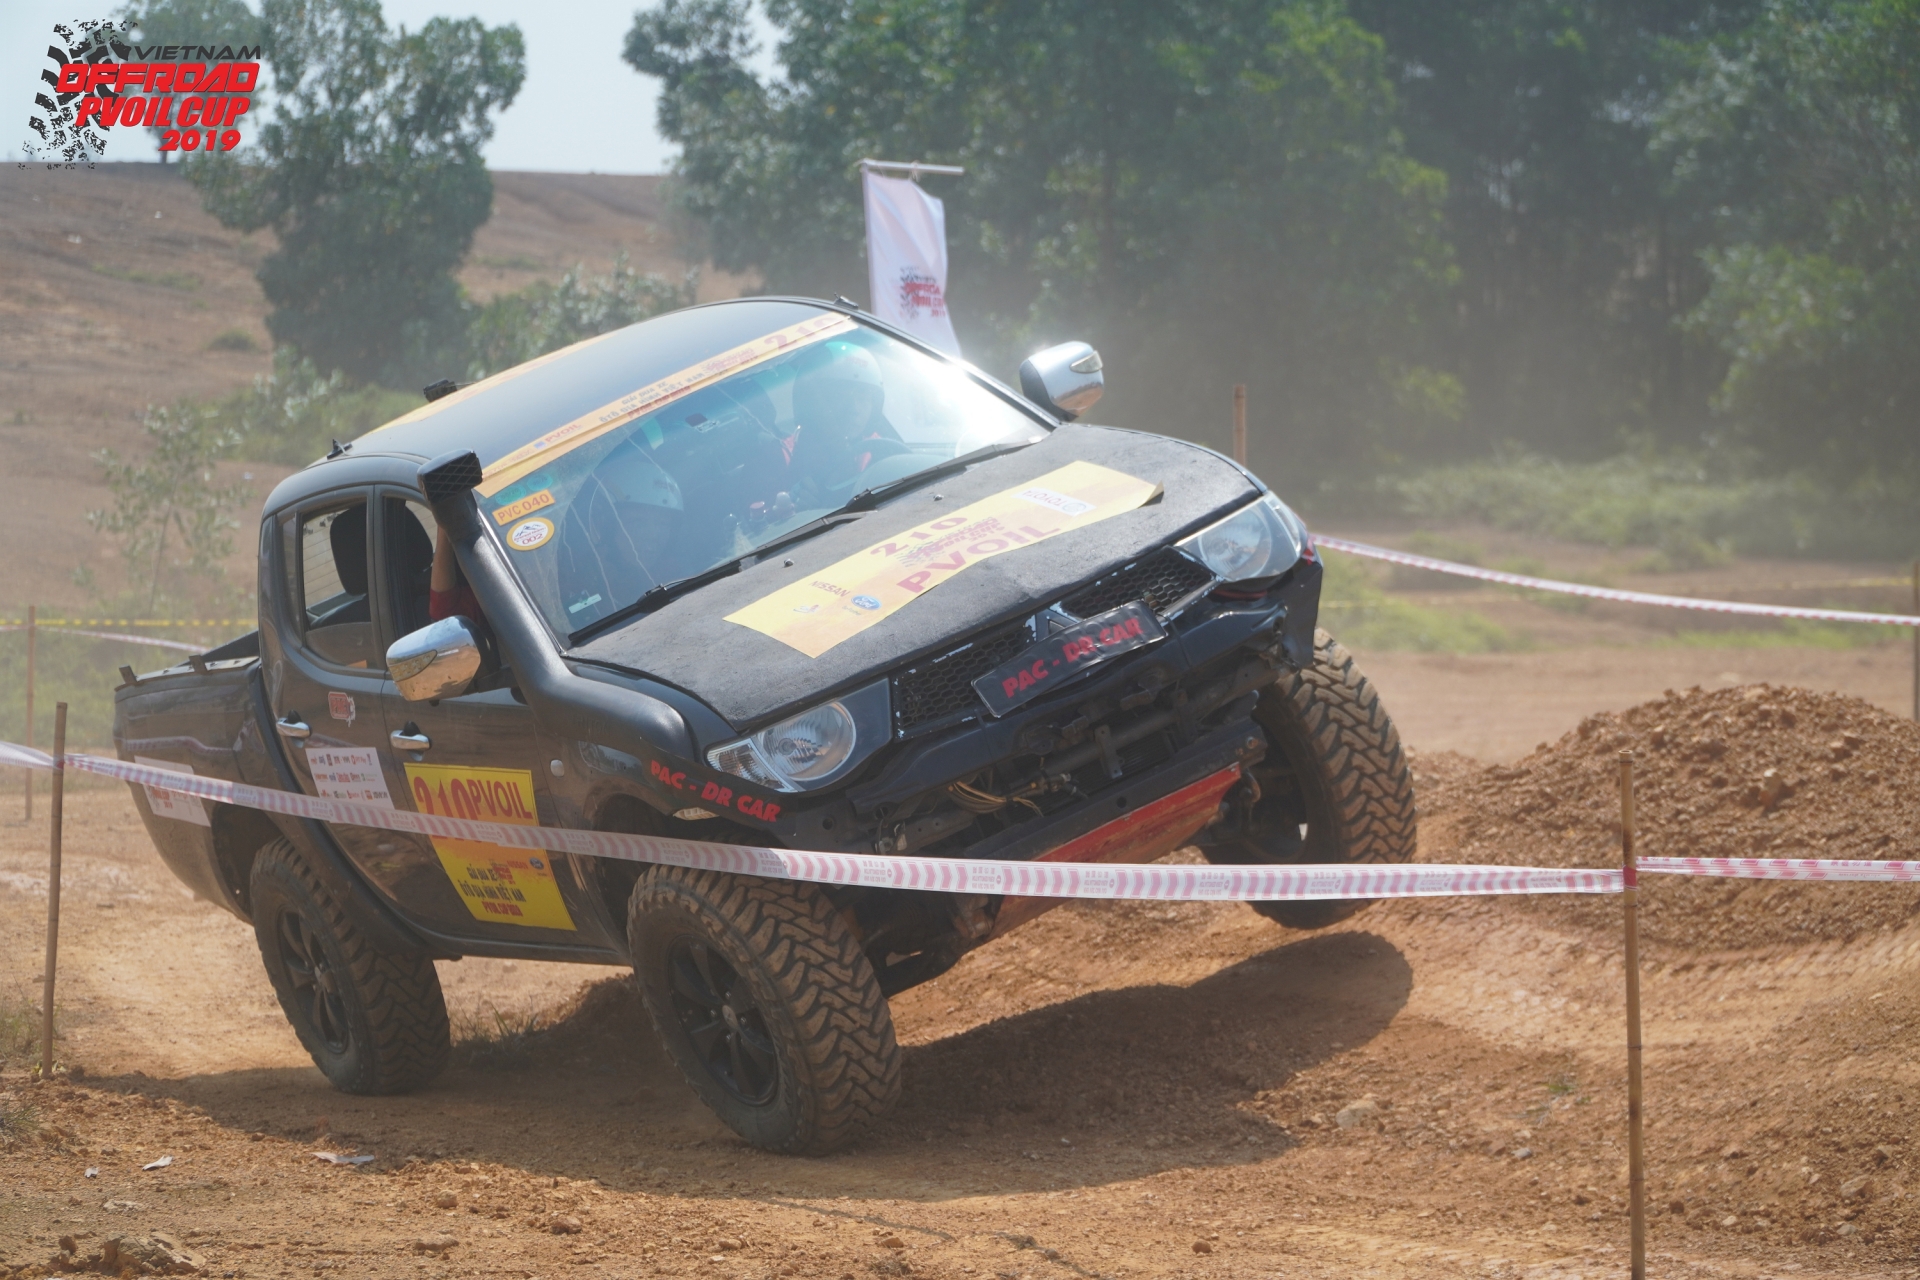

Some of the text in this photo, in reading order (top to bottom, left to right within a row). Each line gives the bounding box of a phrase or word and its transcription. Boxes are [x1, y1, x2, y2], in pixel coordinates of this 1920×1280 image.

[544, 423, 581, 443] PVOIL
[497, 505, 521, 522] PVC
[521, 494, 550, 511] 040
[1022, 490, 1067, 507] TOYOTA
[522, 533, 544, 545] 002
[870, 517, 968, 557] 210
[896, 526, 1061, 594] PVOIL
[809, 581, 851, 597] NISSAN
[853, 596, 880, 609] Ford
[1002, 659, 1048, 698] PAC
[1062, 636, 1097, 663] DR
[1100, 618, 1143, 646] CAR
[466, 779, 533, 820] PVOIL
[651, 760, 686, 789] PAC
[701, 781, 733, 807] DR
[737, 795, 780, 822] CAR
